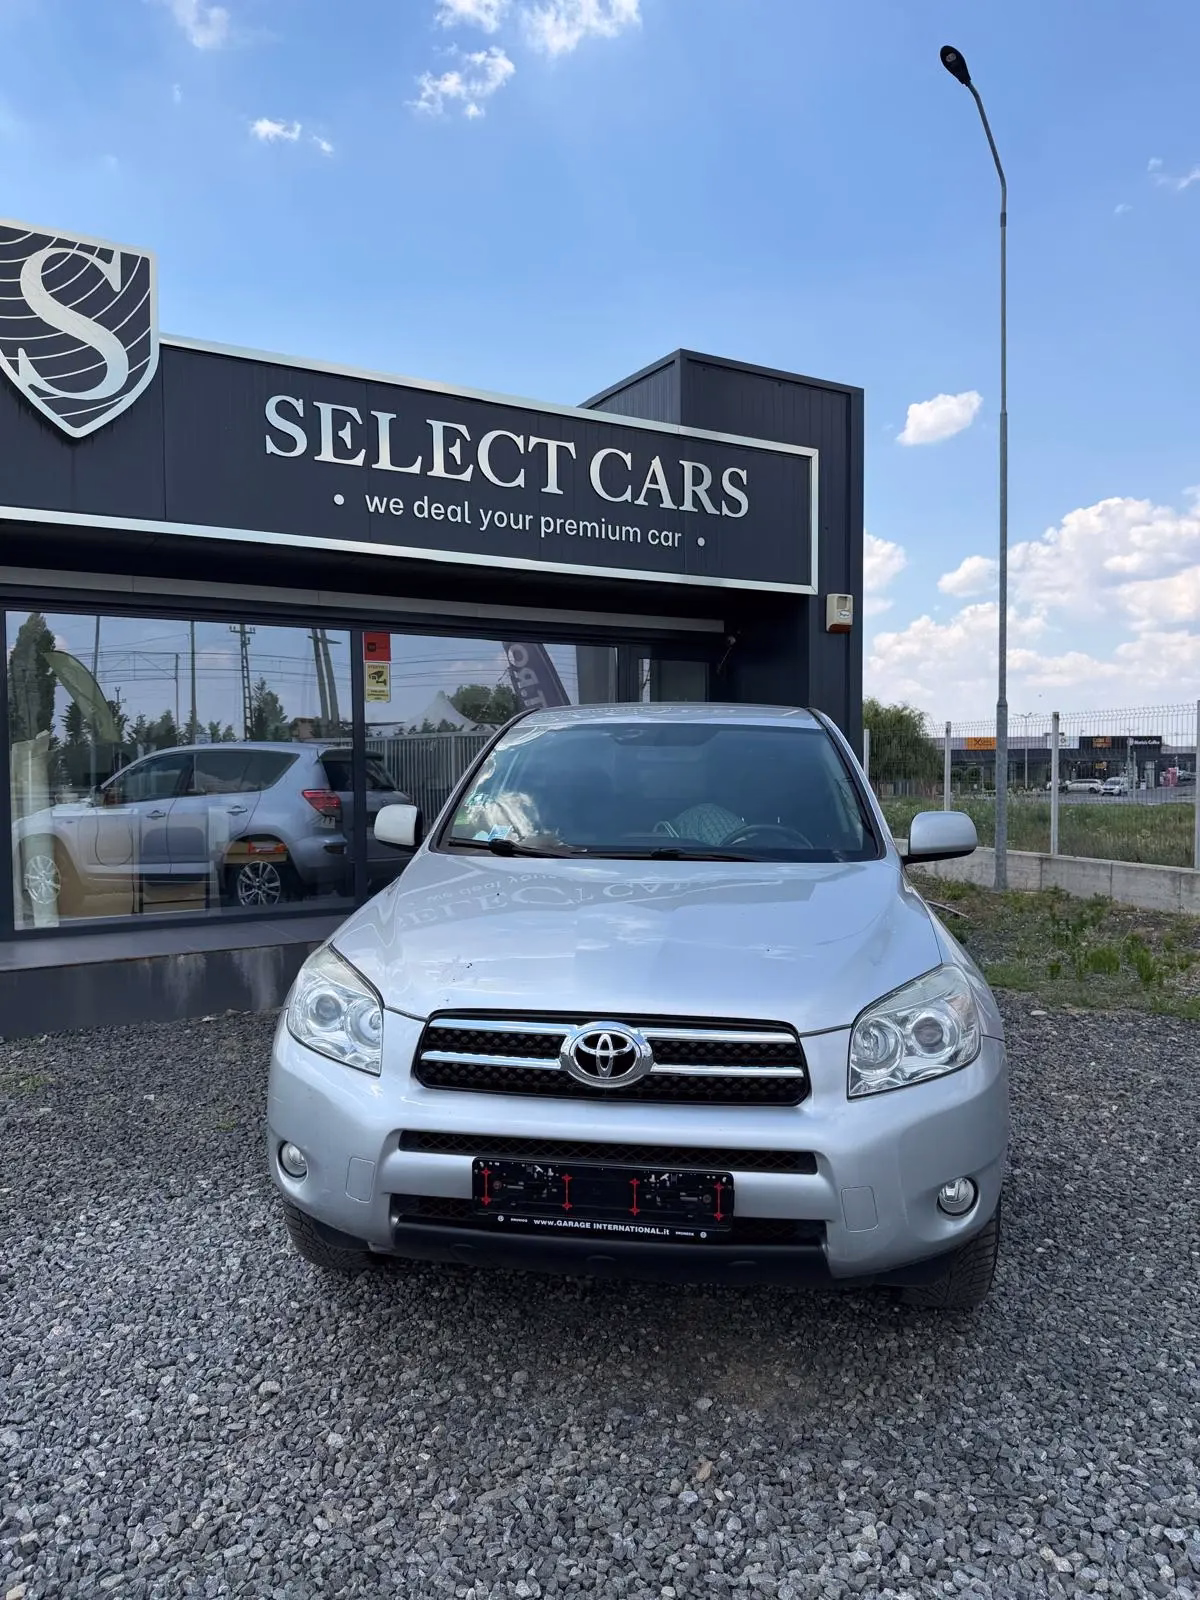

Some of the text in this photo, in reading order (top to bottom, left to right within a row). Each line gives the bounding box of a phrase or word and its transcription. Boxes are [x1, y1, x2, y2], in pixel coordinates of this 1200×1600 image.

[20, 247, 129, 400] S
[265, 395, 749, 518] SELECT CARS
[365, 494, 681, 547] we deal your premium car
[533, 1219, 591, 1229] www.GARAGE
[593, 1222, 670, 1235] INTERNATIONAL.it
